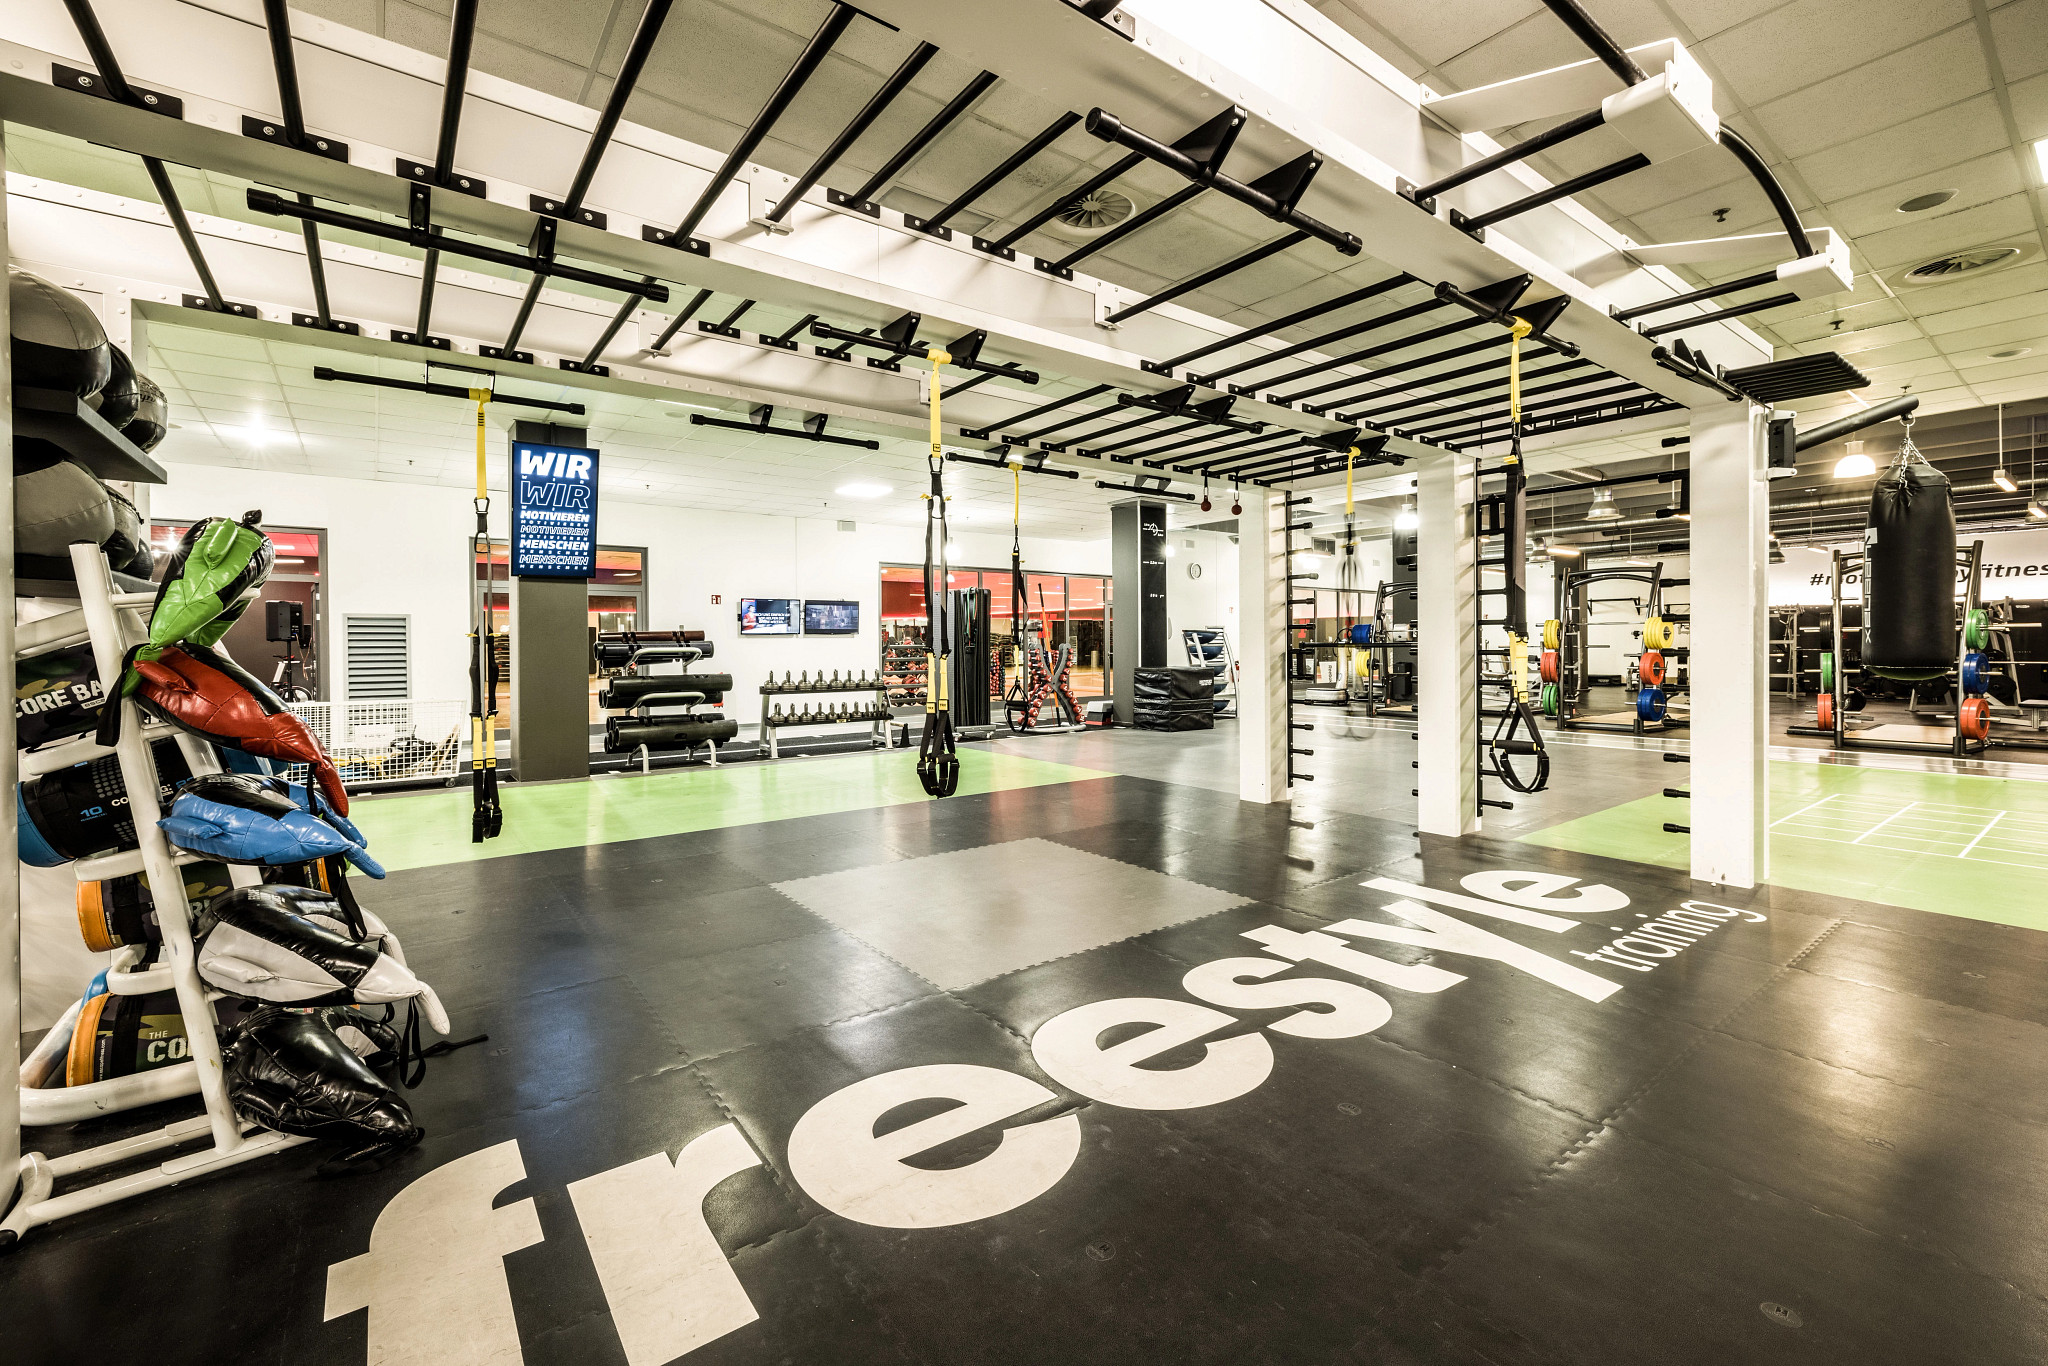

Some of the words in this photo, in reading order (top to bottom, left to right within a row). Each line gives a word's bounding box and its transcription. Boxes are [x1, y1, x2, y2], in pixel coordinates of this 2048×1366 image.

[520, 449, 592, 480] WIR
[520, 481, 591, 509] WIR
[520, 510, 590, 523] MOTIVIEREN
[520, 525, 590, 536] MOTIVIEREN
[519, 539, 590, 551] MENSCHEN
[519, 554, 590, 566] MENSCHEN
[71, 680, 103, 702] BA
[80, 806, 103, 817] 10
[1568, 899, 1768, 972] training
[149, 1030, 169, 1040] THE
[323, 870, 1631, 1366] freestyle
